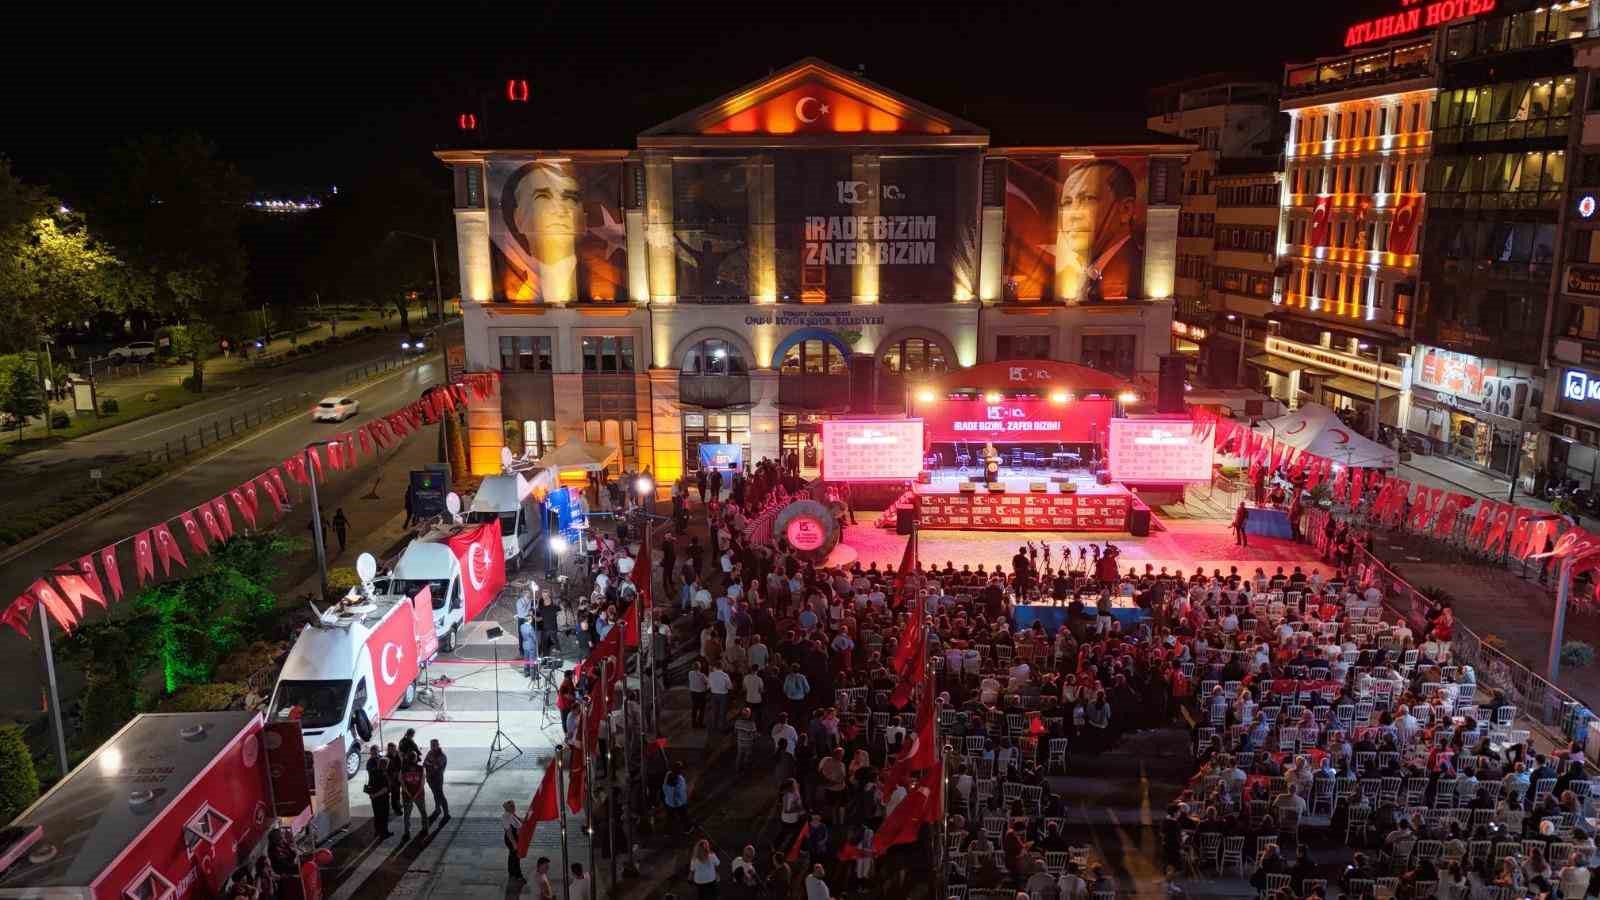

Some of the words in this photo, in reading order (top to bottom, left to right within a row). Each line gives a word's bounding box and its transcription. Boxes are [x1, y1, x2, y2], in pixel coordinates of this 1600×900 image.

[1344, 9, 1421, 47] ATLIHAN
[1425, 0, 1496, 26] HOTEL
[805, 242, 871, 265] ZAFER
